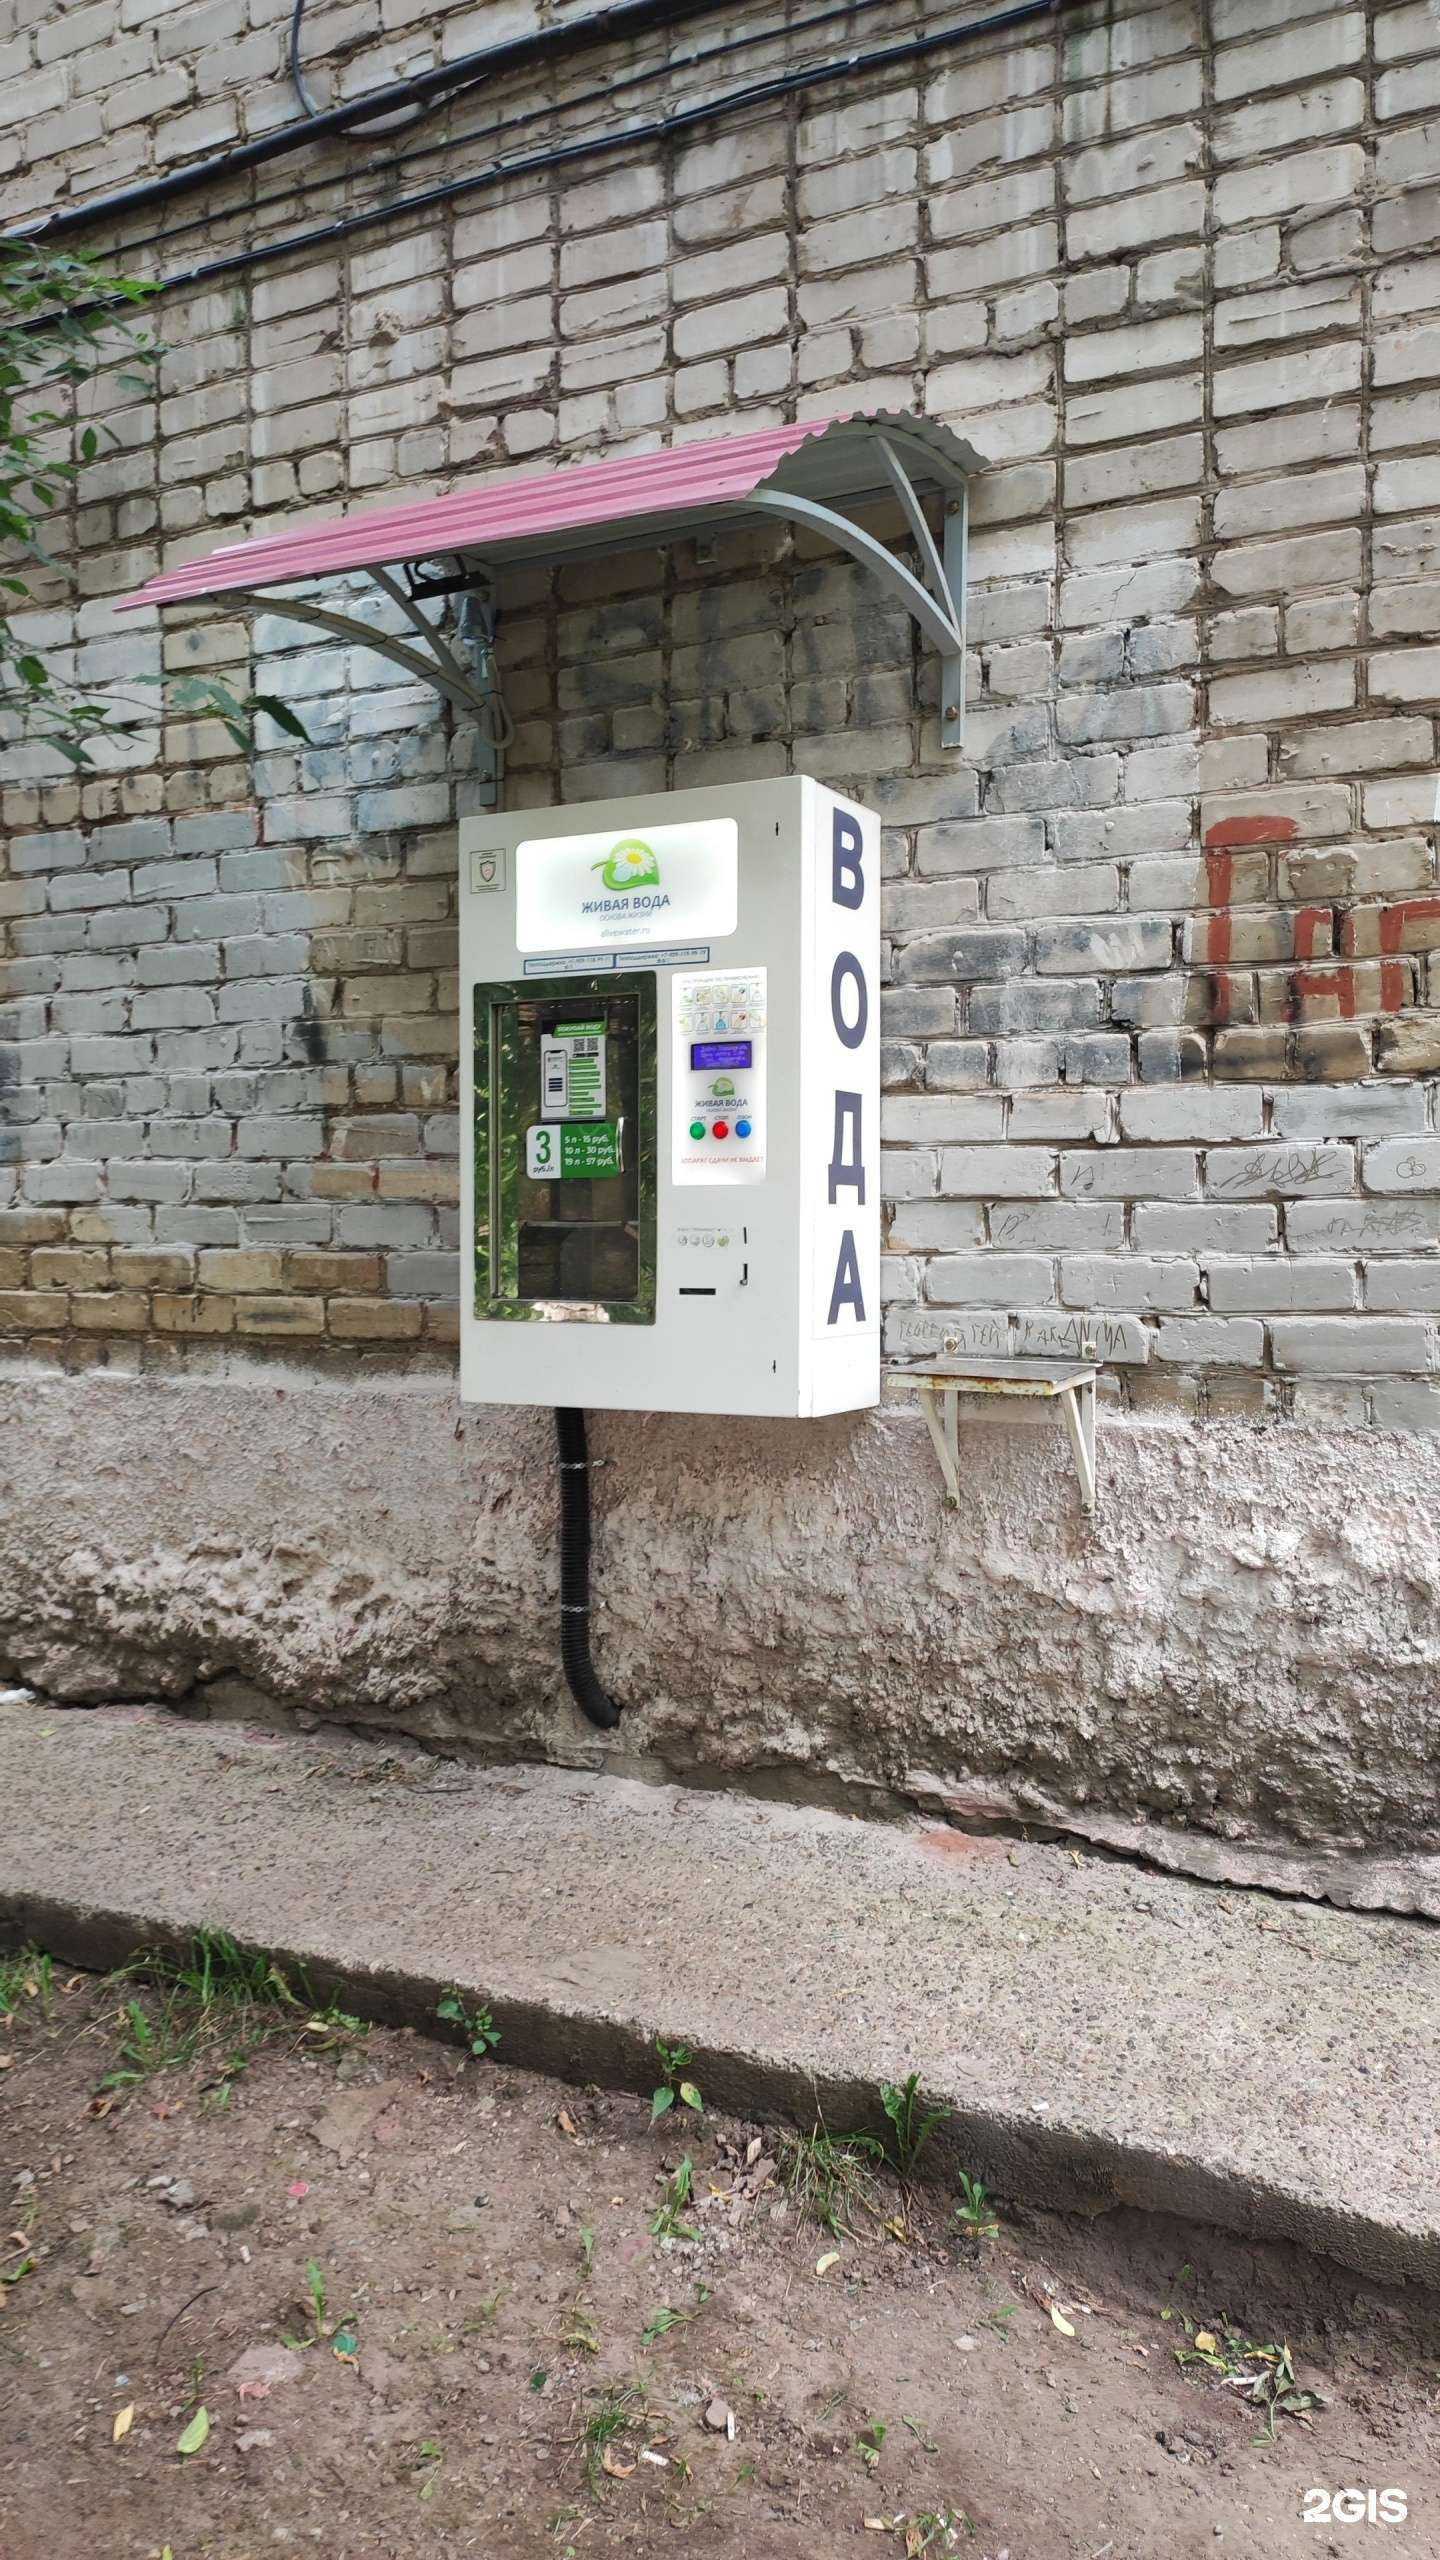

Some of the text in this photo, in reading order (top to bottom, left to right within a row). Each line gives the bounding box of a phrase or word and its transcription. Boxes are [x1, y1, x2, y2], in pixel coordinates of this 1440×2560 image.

[581, 895, 671, 914] ЖИВАЯ ВОДА
[828, 806, 868, 1326] ВОДА
[695, 1098, 749, 1108] ЖИВАЯ ВОДА
[535, 1130, 551, 1164] 3
